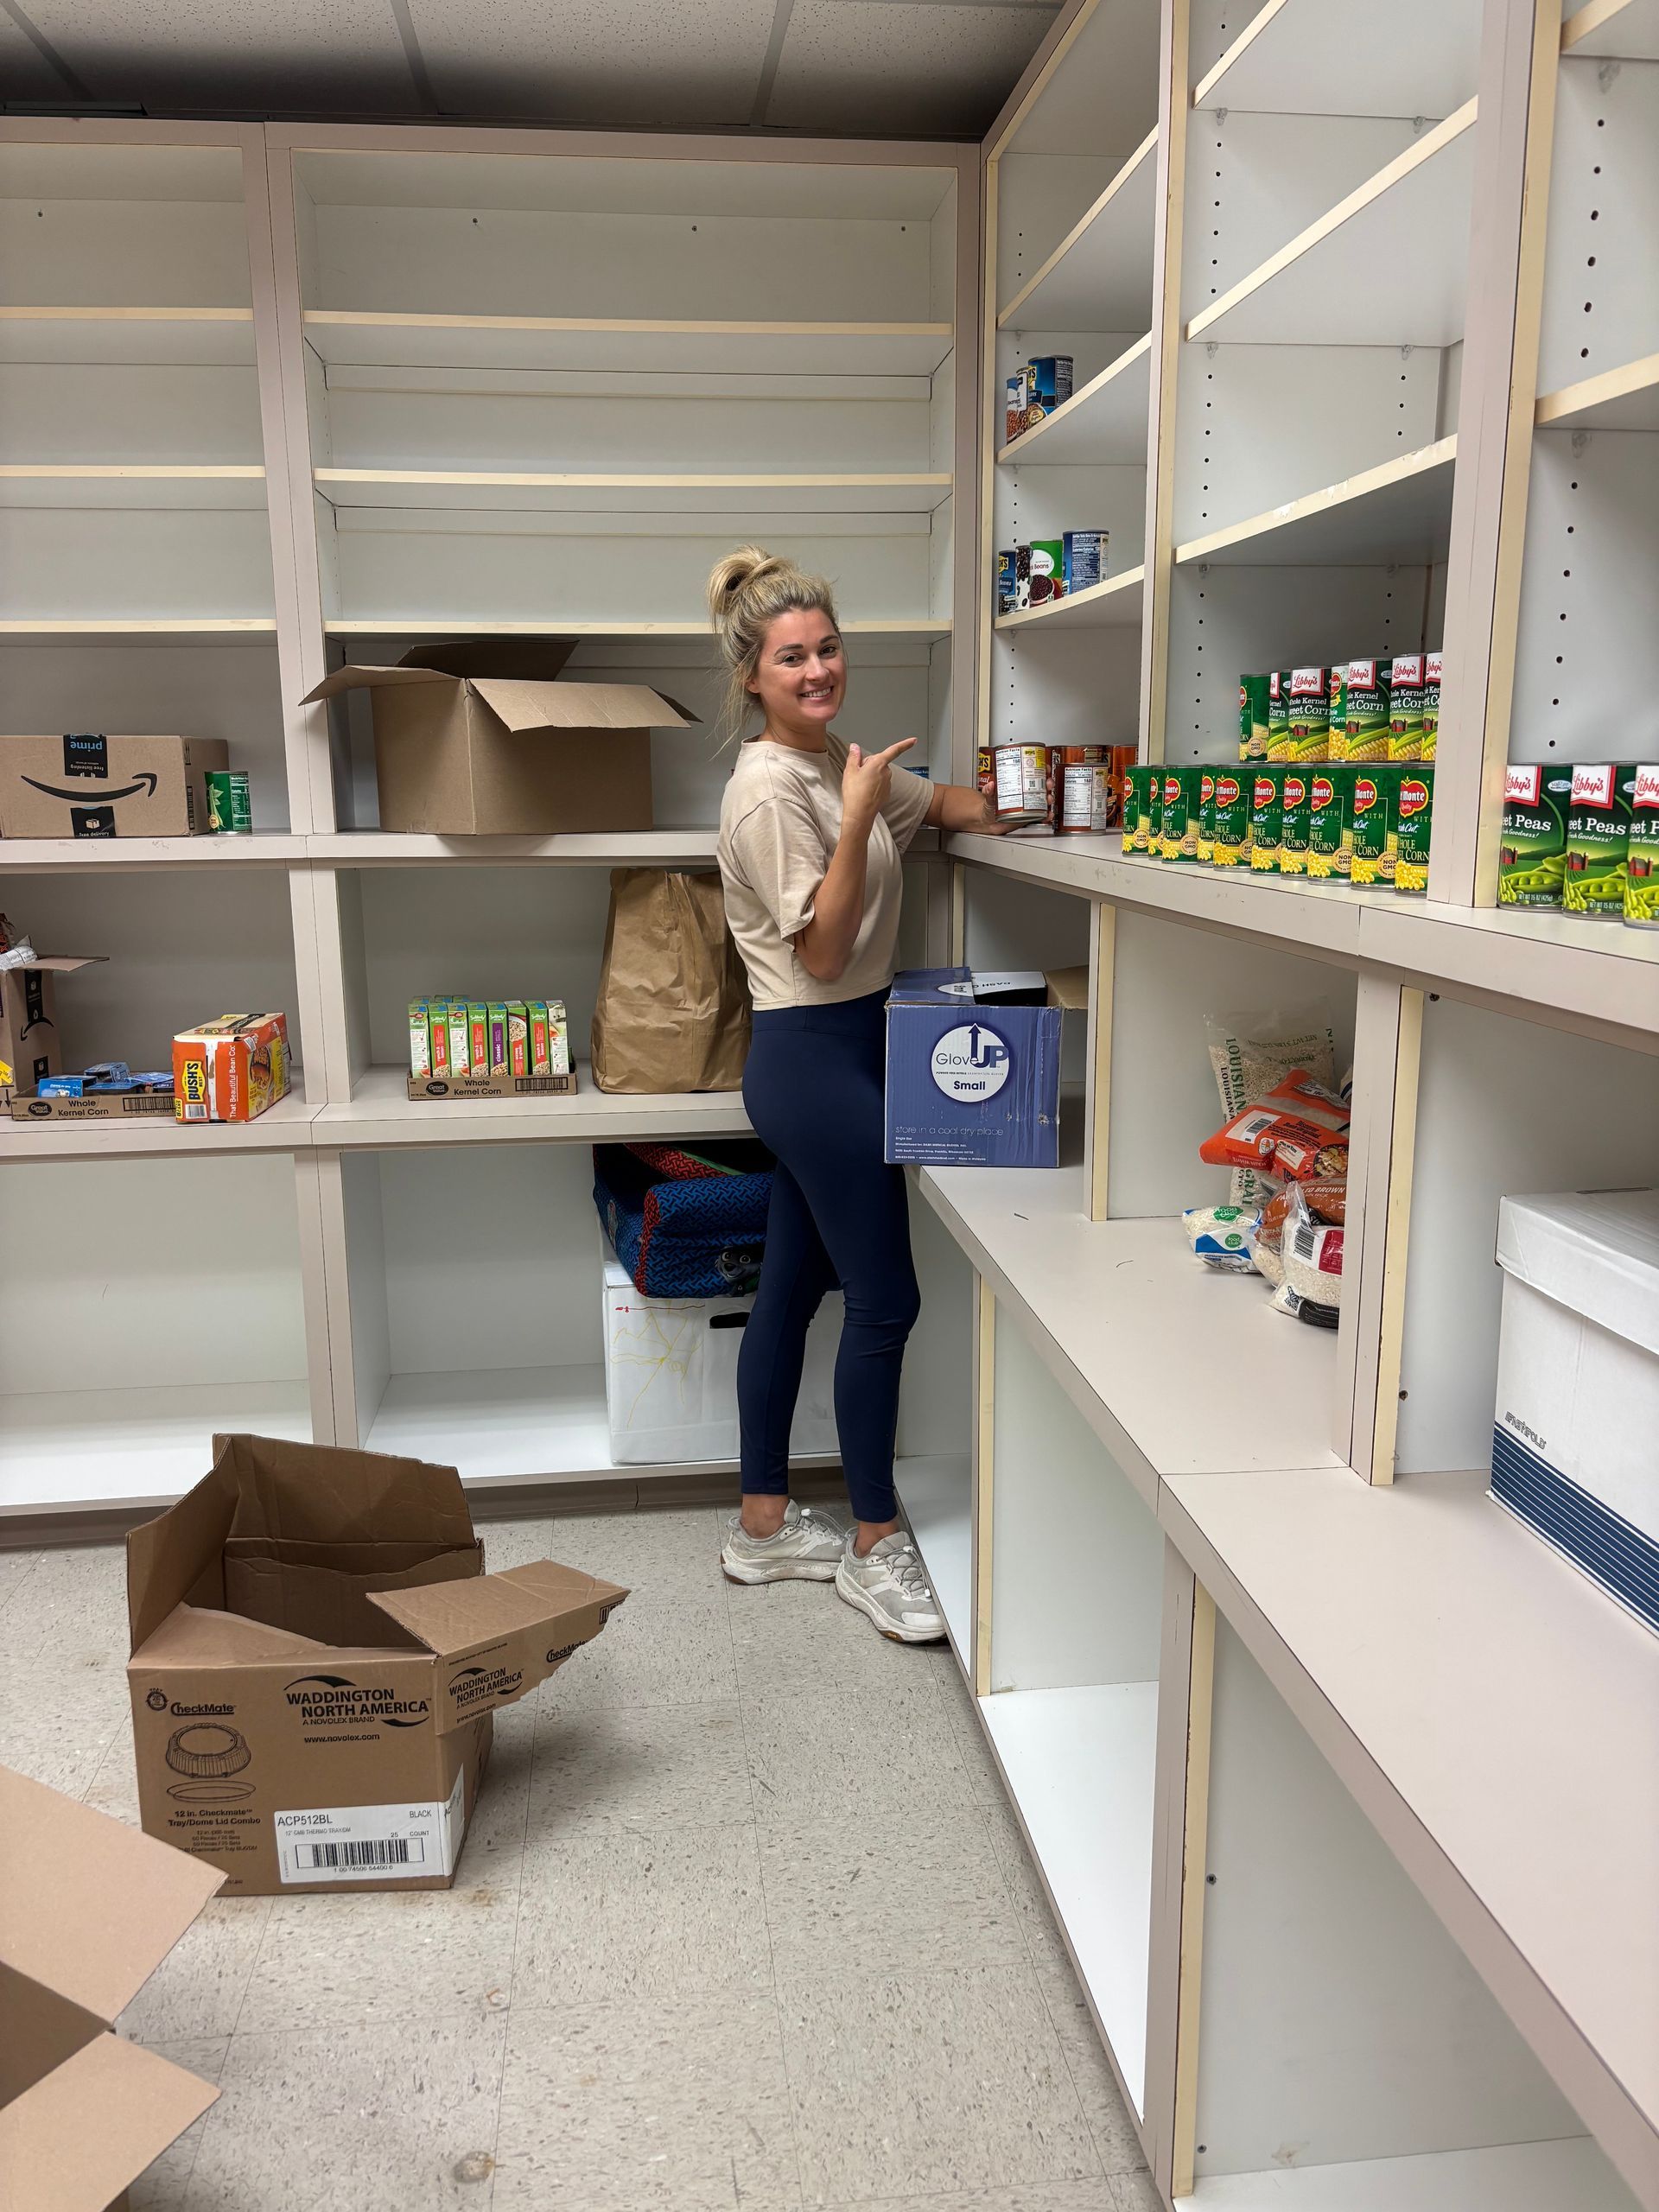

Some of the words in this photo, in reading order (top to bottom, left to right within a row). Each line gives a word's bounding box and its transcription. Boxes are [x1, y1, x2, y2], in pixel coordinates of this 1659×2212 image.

[1294, 672, 1318, 688] Libby's
[1304, 705, 1331, 715] Corn
[1357, 700, 1384, 711] Corn
[70, 741, 103, 752] prime
[979, 756, 989, 768] H'S
[1573, 772, 1605, 795] Libby's
[1402, 791, 1425, 802] Monte
[1516, 815, 1552, 831] Peas
[1586, 817, 1627, 836] Peas
[1166, 830, 1182, 838] CORN
[1224, 834, 1241, 843] CORN
[1578, 832, 1613, 843] Goodness!
[1259, 836, 1277, 846] CORN
[1287, 838, 1306, 849] CORN
[1315, 841, 1335, 851] CORN
[1357, 845, 1379, 856] CORN
[1406, 849, 1430, 861] CORN
[1225, 1038, 1246, 1110] LOUISIAN
[187, 1063, 200, 1100] BUSH'S
[953, 1081, 985, 1090] Small
[454, 1087, 480, 1096] Kernel
[68, 1099, 97, 1108] Whole
[960, 1127, 975, 1136] dry
[449, 1668, 506, 1696] WADDINGTON
[456, 1685, 486, 1704] NORTH
[486, 1670, 522, 1692] AMERICA
[287, 1689, 394, 1705] WADDINGTON
[481, 1691, 495, 1700] BRAND
[171, 1702, 234, 1716] CheckMate
[302, 1704, 355, 1718] NORTH
[359, 1700, 429, 1715] AMERICA
[304, 1734, 380, 1743] www.novolex.com
[168, 1819, 213, 1827] Tray/Dome
[277, 1815, 333, 1827] ACP512BL
